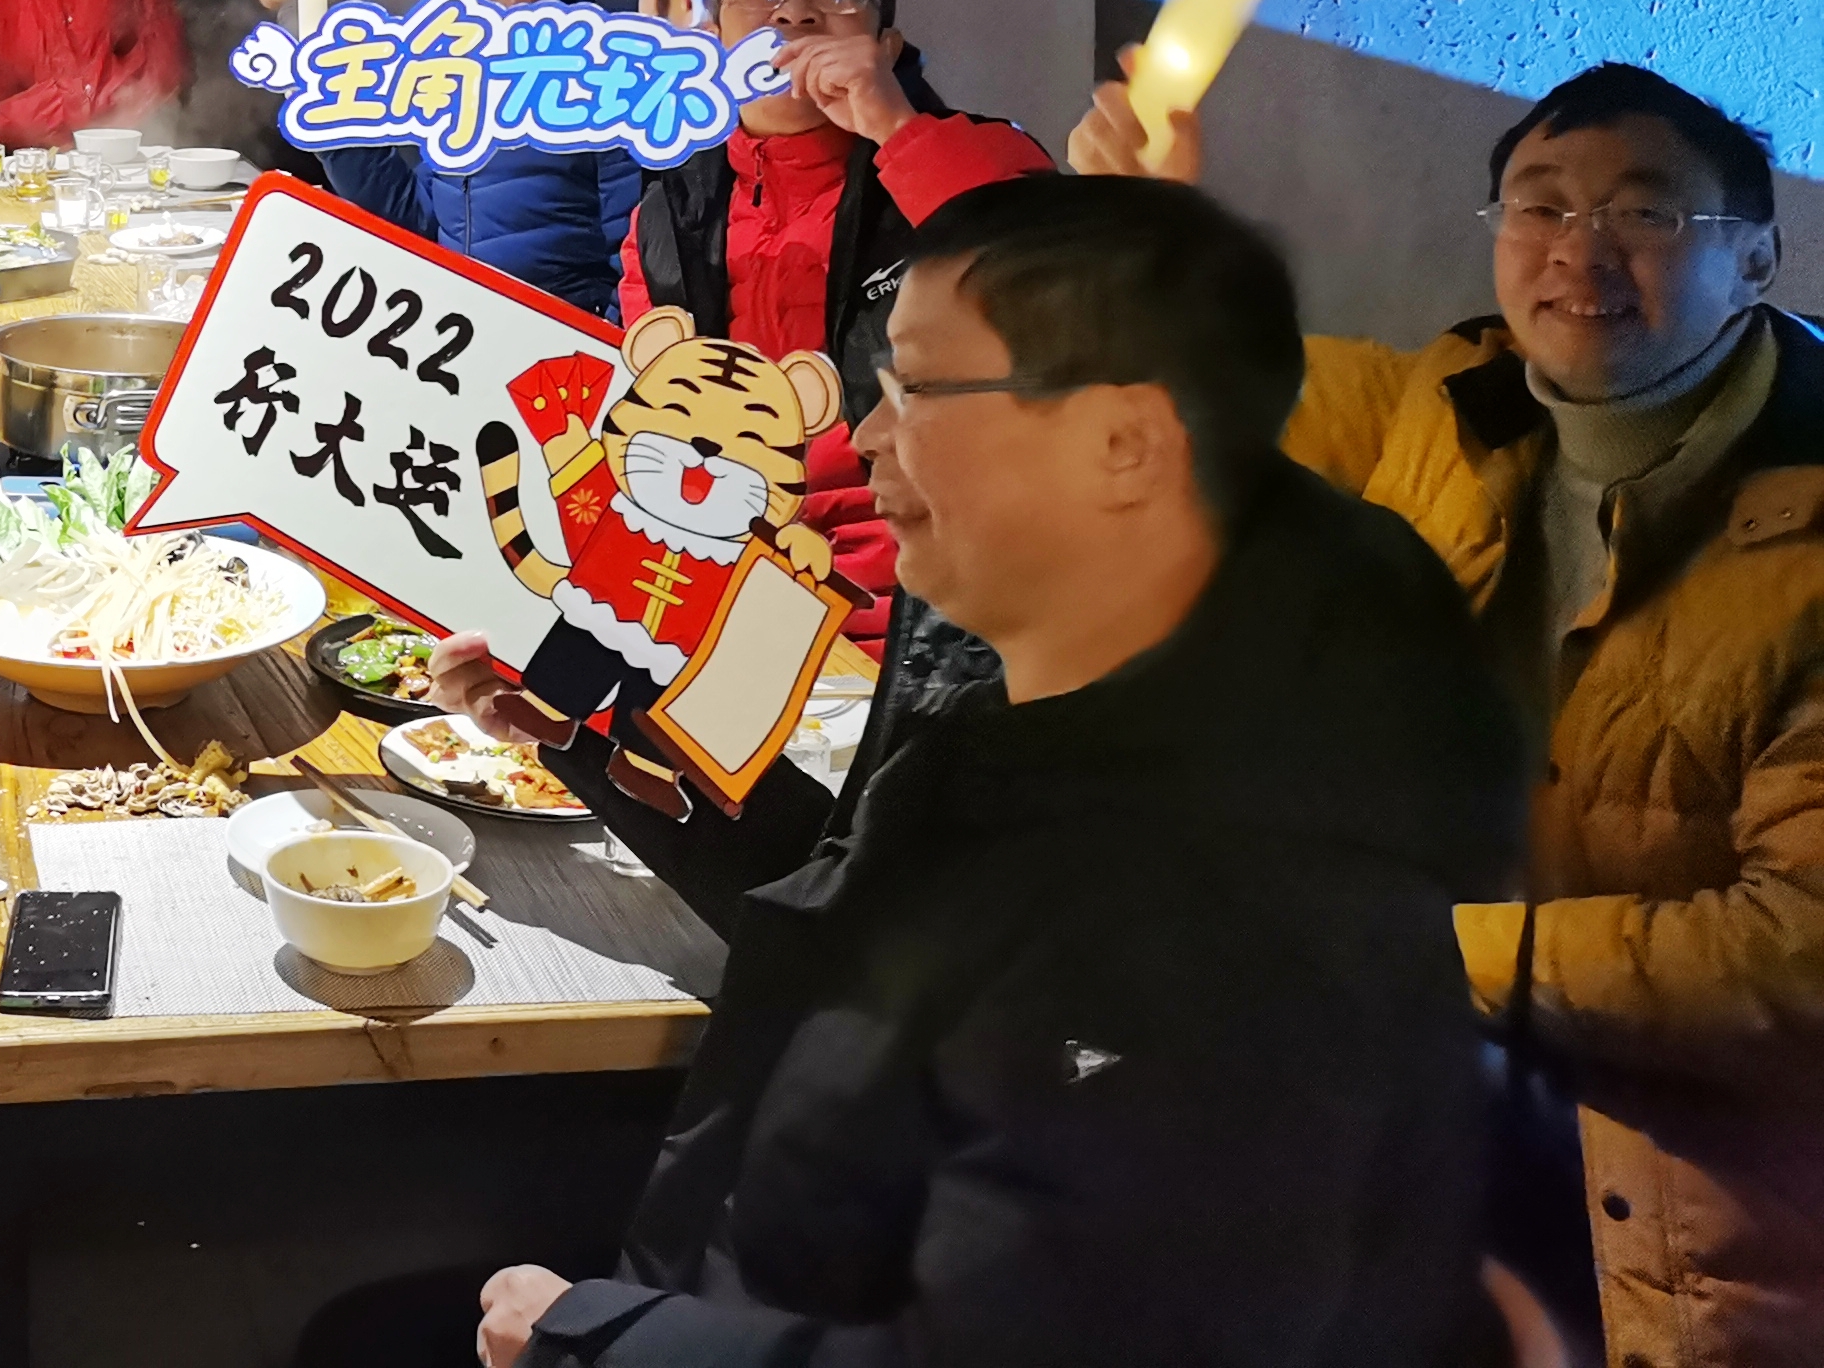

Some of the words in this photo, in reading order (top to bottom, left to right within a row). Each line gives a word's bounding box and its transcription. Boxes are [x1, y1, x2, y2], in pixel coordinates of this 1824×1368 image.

[304, 6, 712, 150] 主角光环
[270, 241, 475, 396] 2022
[213, 345, 464, 560] 行大运
